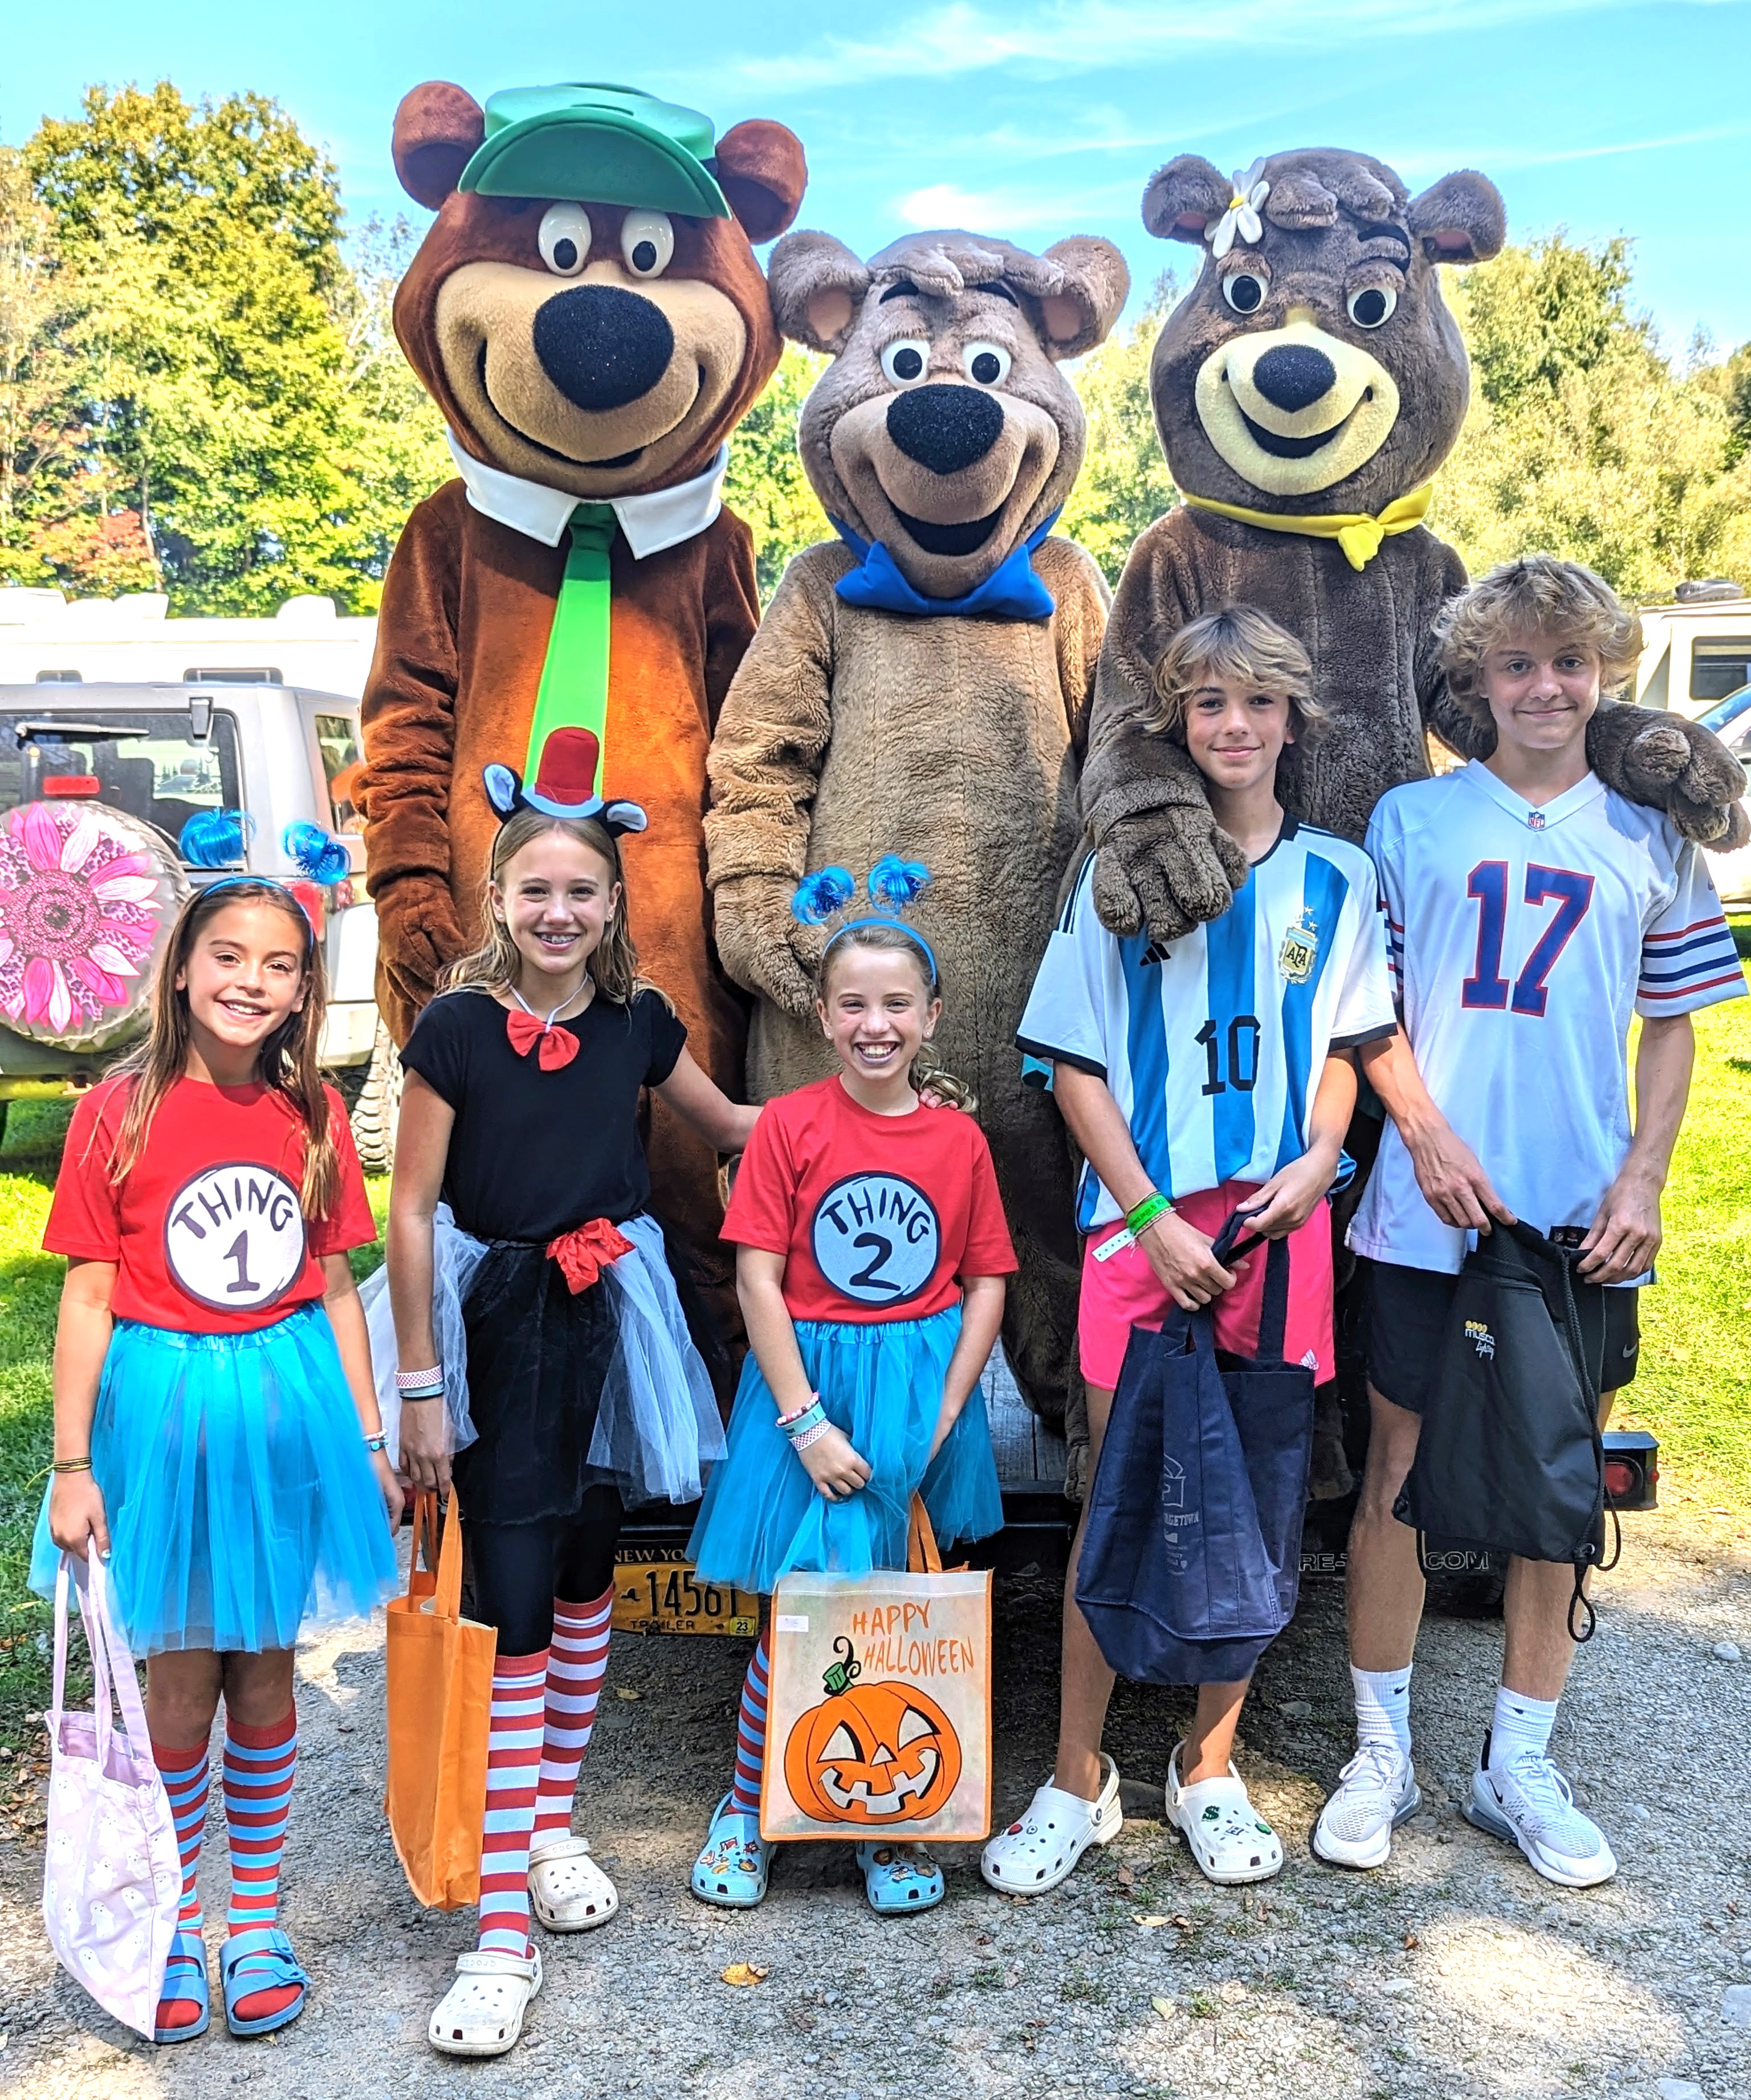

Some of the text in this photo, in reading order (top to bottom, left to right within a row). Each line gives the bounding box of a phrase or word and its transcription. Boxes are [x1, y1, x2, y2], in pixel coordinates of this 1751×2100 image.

[1529, 817, 1545, 829] NFL
[1285, 941, 1308, 968] AFA
[1461, 860, 1595, 1018] 17
[1194, 1015, 1261, 1096] 10
[172, 1177, 294, 1239] THING
[820, 1186, 931, 1244] THING
[223, 1230, 260, 1293] 1
[849, 1232, 902, 1292] 2
[614, 1549, 685, 1562] NEW YO
[646, 1569, 737, 1617] 14561
[853, 1598, 931, 1636] HAPPY
[736, 1621, 748, 1631] 23
[864, 1635, 974, 1676] HALLOWEEN
